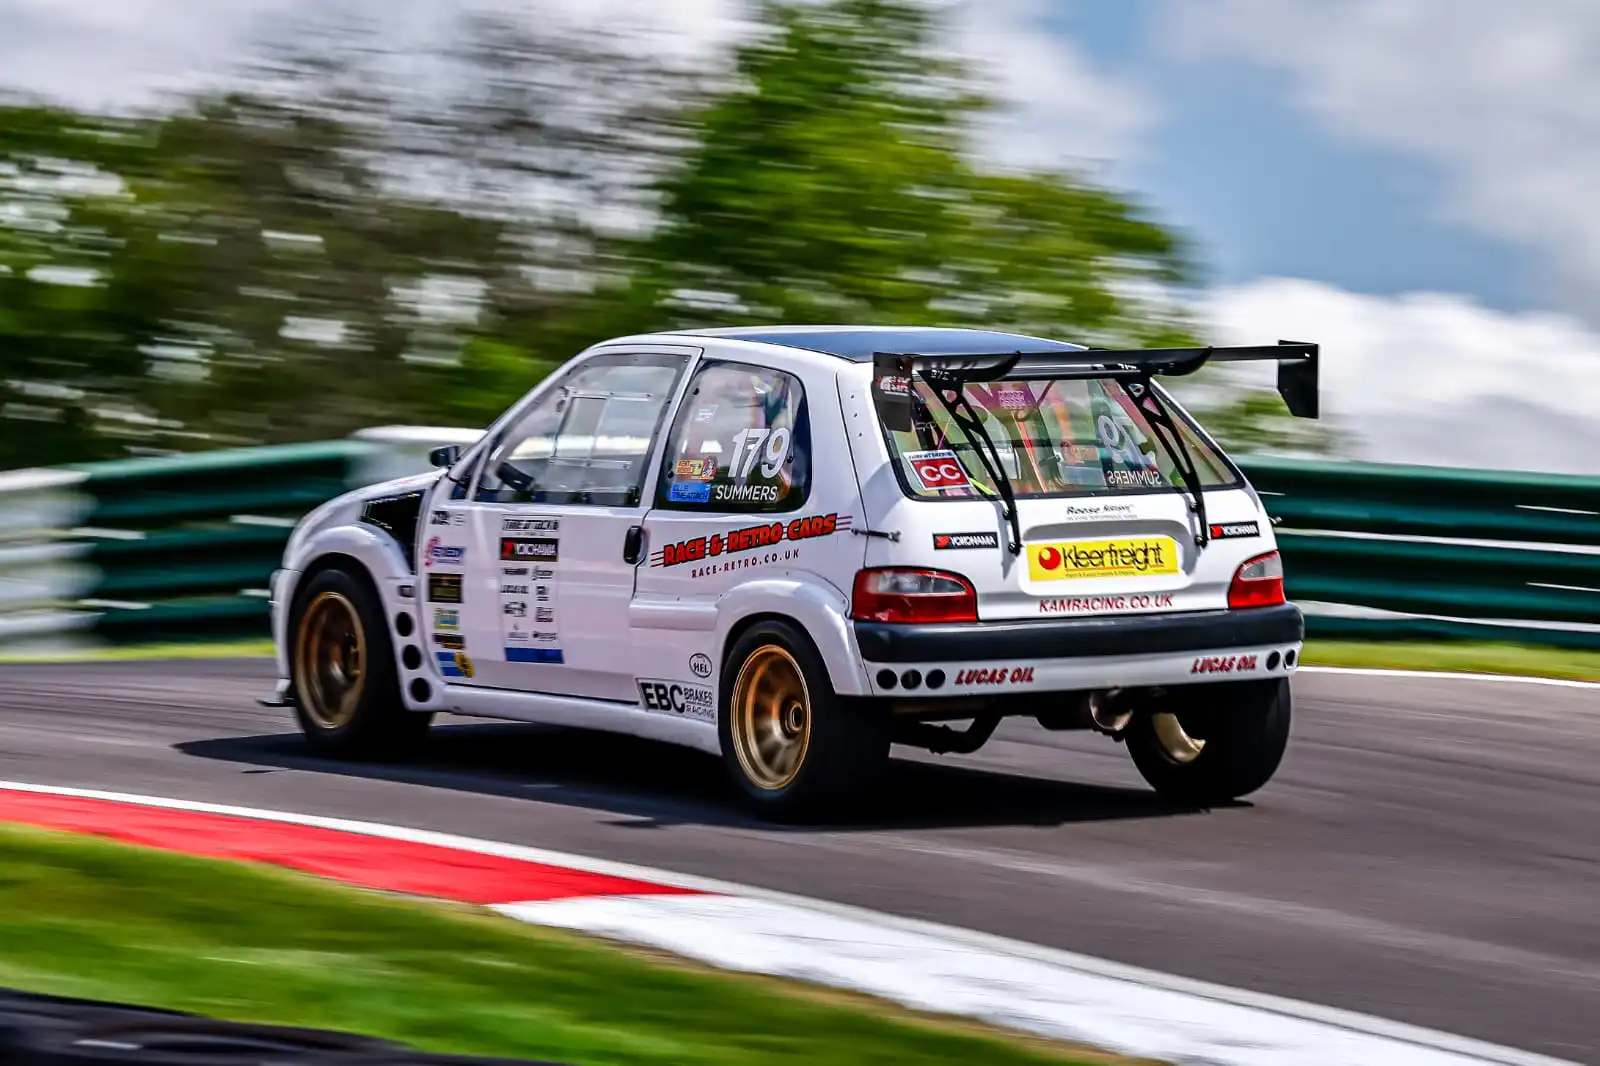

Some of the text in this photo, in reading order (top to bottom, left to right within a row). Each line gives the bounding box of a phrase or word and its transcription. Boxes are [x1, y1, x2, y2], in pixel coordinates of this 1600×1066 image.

[728, 427, 790, 479] 179
[920, 464, 961, 482] CC
[715, 485, 778, 501] SUMMERS
[664, 513, 838, 567] RACE & RETRO CARS
[1221, 525, 1258, 537] YOKOHAMA
[514, 543, 557, 556] YOKOHAMA
[949, 535, 997, 547] YOKOHAMA
[691, 548, 800, 579] RACE-RETRO.CO.UK
[1039, 594, 1174, 613] KAMRACING.CO.UK
[693, 662, 709, 674] HEL
[1190, 655, 1258, 674] LUCAS OIL
[955, 667, 1035, 685] LUCAS OIL
[640, 682, 713, 714] EBC BRAKES
